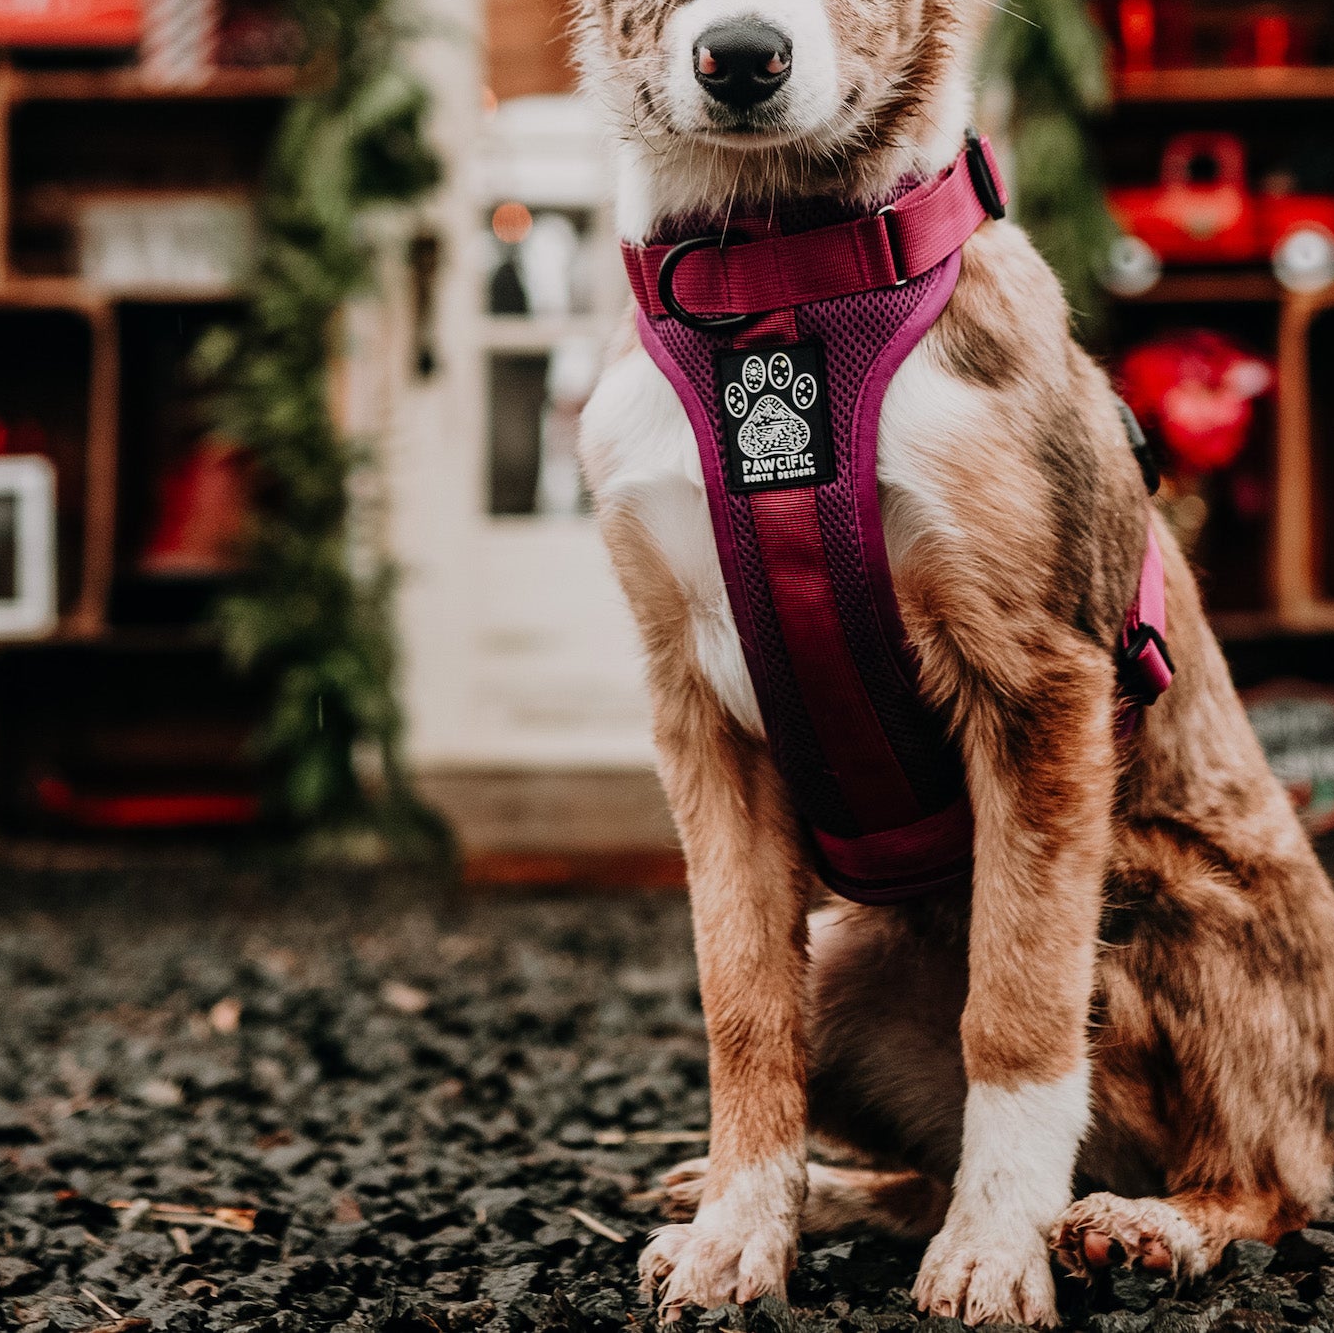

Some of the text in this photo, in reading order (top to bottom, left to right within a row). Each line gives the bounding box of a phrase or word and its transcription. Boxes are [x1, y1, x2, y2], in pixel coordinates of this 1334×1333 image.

[742, 453, 815, 474] PAWCIFIC
[743, 467, 816, 483] NORTH DESIGNS
